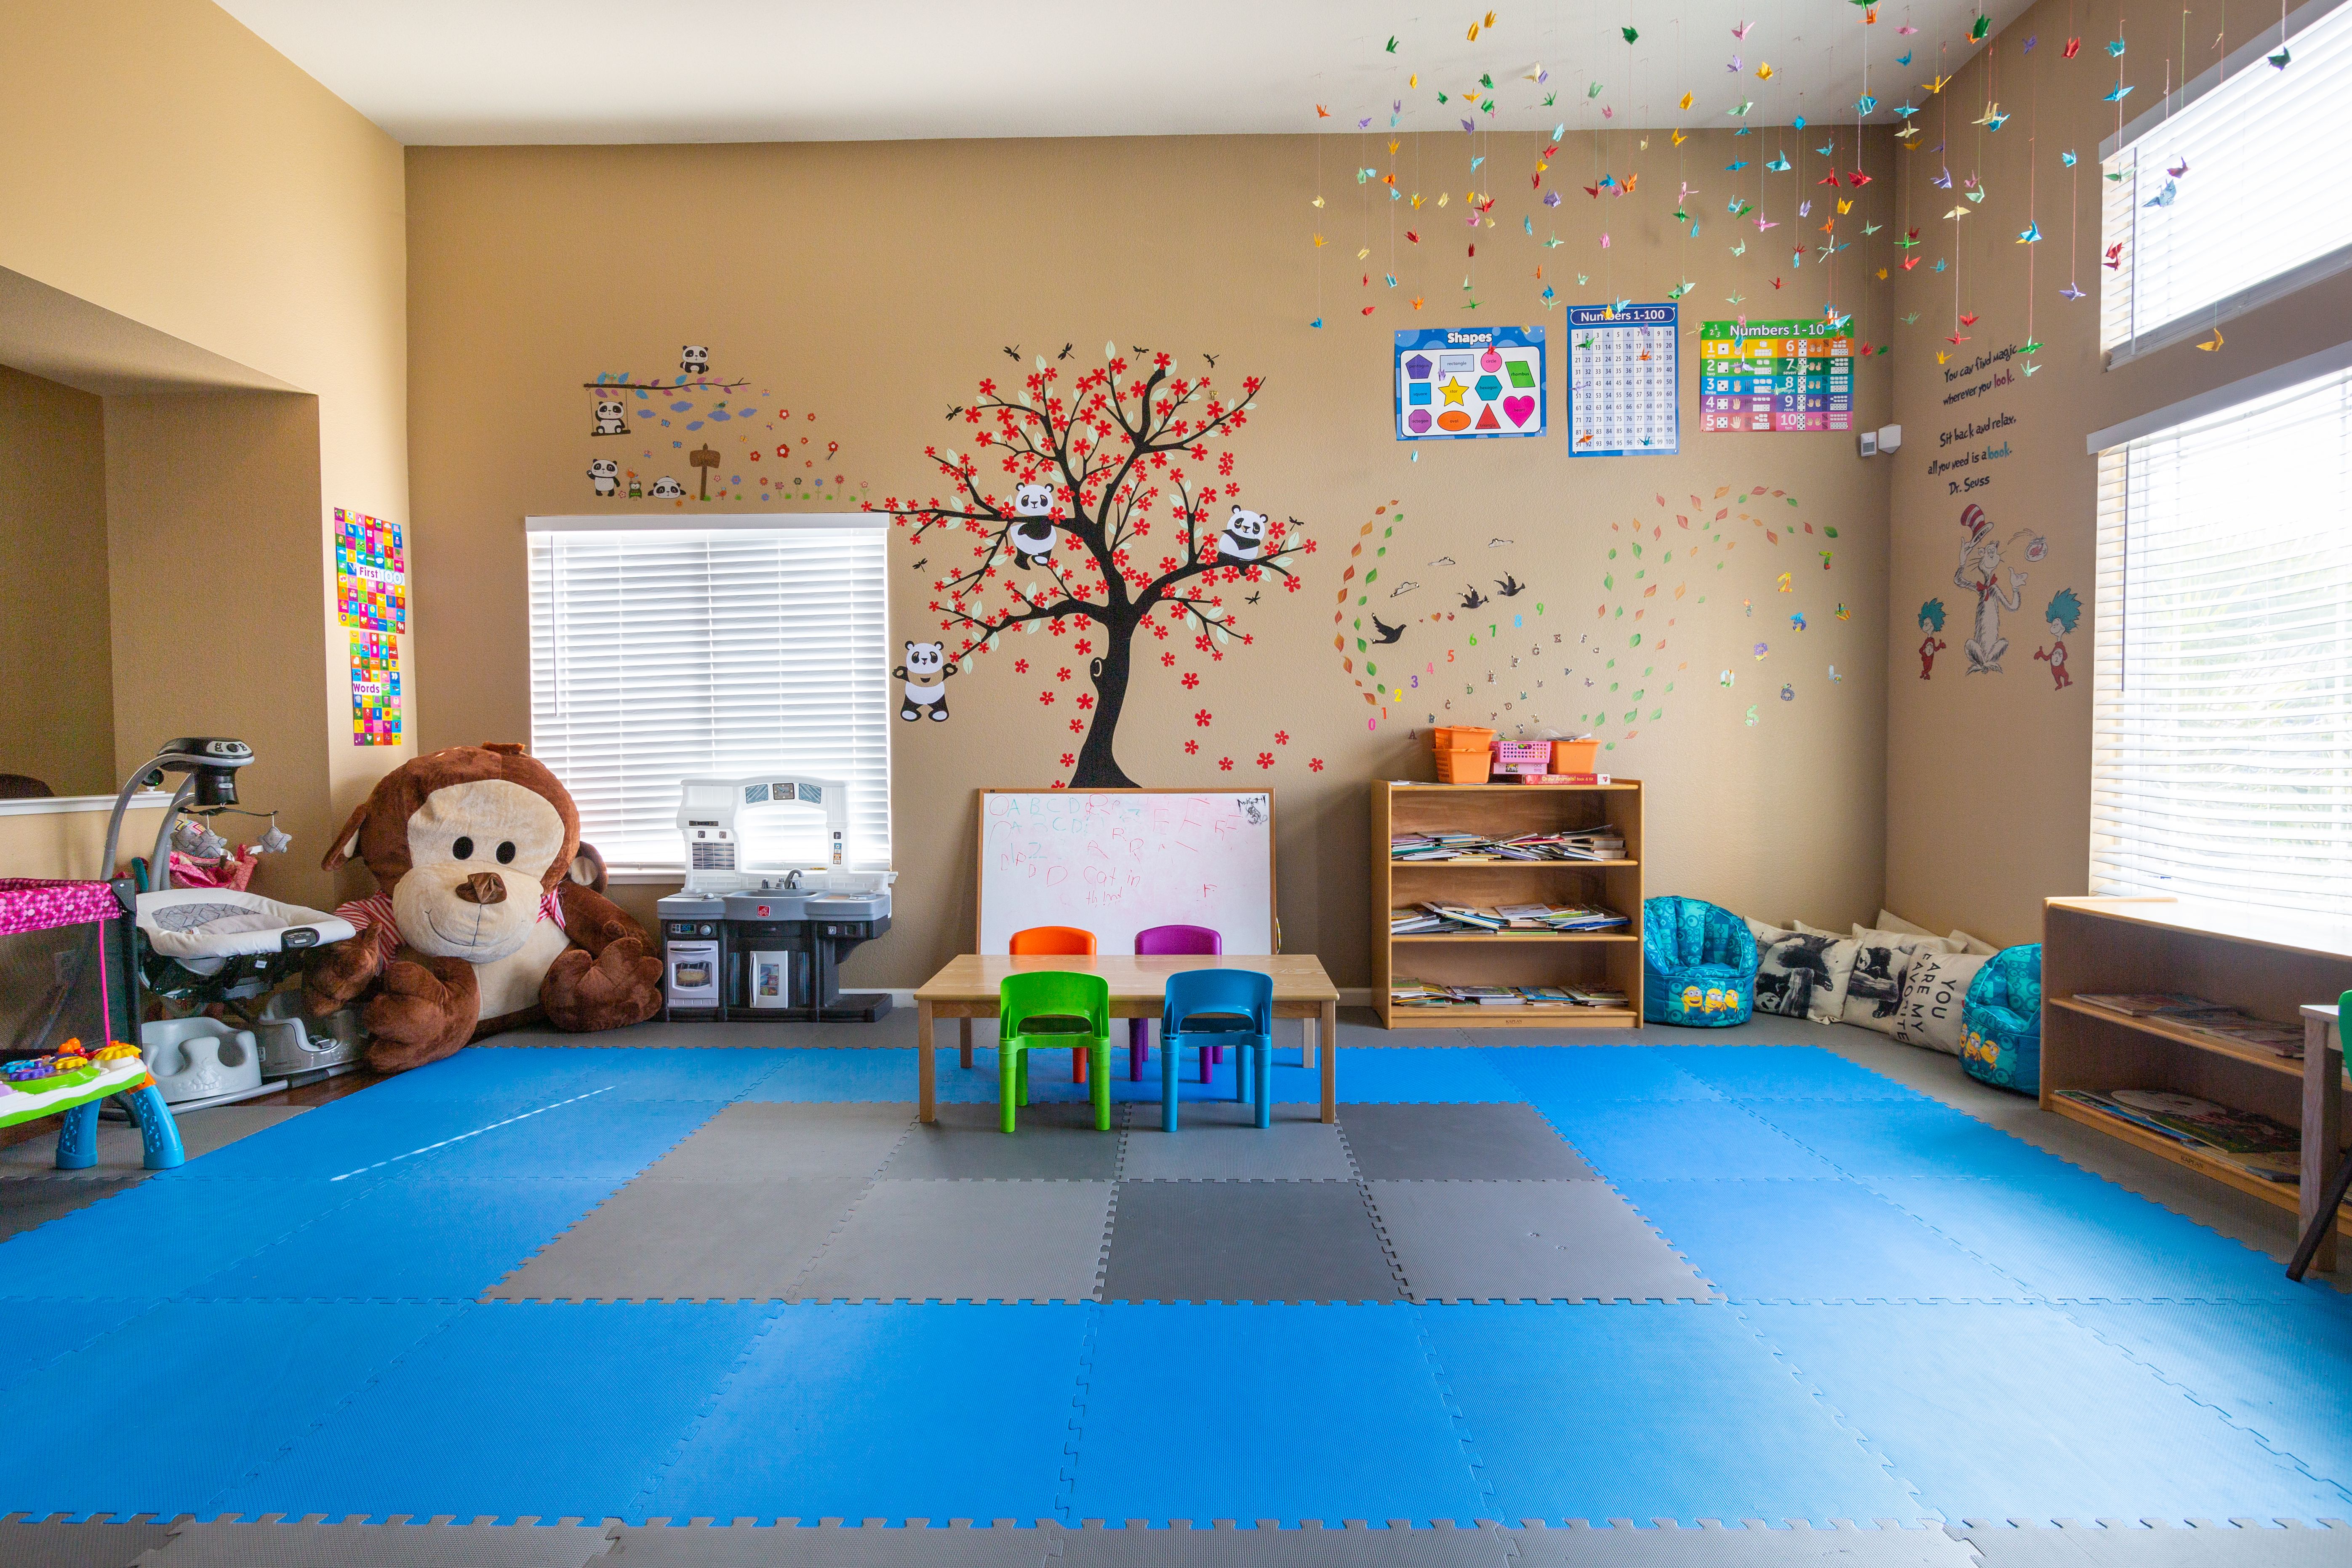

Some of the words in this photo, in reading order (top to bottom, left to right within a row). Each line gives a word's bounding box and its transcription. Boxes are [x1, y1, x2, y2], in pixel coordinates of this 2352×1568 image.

[1634, 310, 1665, 320] 1-100
[1448, 332, 1492, 345] Shapes
[1730, 324, 1789, 336] Numbers
[1792, 323, 1825, 336] 1-10
[1707, 342, 1715, 353] 1
[1786, 340, 1794, 352] 6
[1707, 360, 1715, 371] 2
[1786, 358, 1794, 370] 7
[1944, 368, 1958, 383] You
[1960, 365, 1973, 377] can
[1975, 352, 1991, 371] find
[1993, 344, 2017, 363] magic
[1707, 378, 1715, 389] 3
[1785, 376, 1793, 388] 8
[1943, 386, 1977, 405] wherever
[1979, 381, 1992, 397] you
[1994, 368, 2015, 388] look.
[1706, 397, 1715, 408] 4
[1785, 395, 1793, 407] 9
[1707, 415, 1714, 426] 5
[1781, 414, 1797, 426] 10
[1940, 432, 1951, 447] Sit
[1955, 423, 1974, 441] back
[1976, 417, 1990, 435] and
[1992, 412, 2016, 430] relax,
[1928, 460, 1937, 475] all
[1938, 461, 1951, 476] you
[1952, 452, 1969, 470] need
[1972, 452, 1979, 463] is
[1981, 451, 1987, 460] a
[1987, 441, 2012, 459] book.
[1949, 481, 1962, 495] Dr.
[1964, 476, 1990, 492] Seuss
[1819, 551, 1833, 570] 7
[360, 567, 378, 578] First
[380, 569, 403, 585] 100
[1777, 571, 1792, 592] 2
[1368, 718, 1376, 731] 0
[1381, 707, 1387, 720] 1
[1395, 689, 1402, 702] 2
[1411, 675, 1418, 688] 3
[1427, 662, 1434, 674] 4
[1448, 650, 1454, 662] 5
[1469, 633, 1477, 646] 6
[1489, 624, 1496, 637] 7
[1514, 614, 1523, 628] 8
[1536, 603, 1544, 616] 9
[353, 683, 379, 693] Words
[1780, 683, 1795, 701] 6
[1409, 730, 1416, 739] A
[1429, 715, 1435, 723] B
[1467, 686, 1473, 694] D
[1745, 704, 1759, 727] 5
[1007, 799, 1020, 817] A
[1030, 797, 1040, 814] B
[1047, 798, 1061, 813] C
[1083, 866, 1116, 887] Cat
[1127, 869, 1141, 888] in
[1917, 962, 1941, 995] ARE
[1931, 980, 1957, 1019] YOU
[1911, 1003, 1924, 1033] MY
